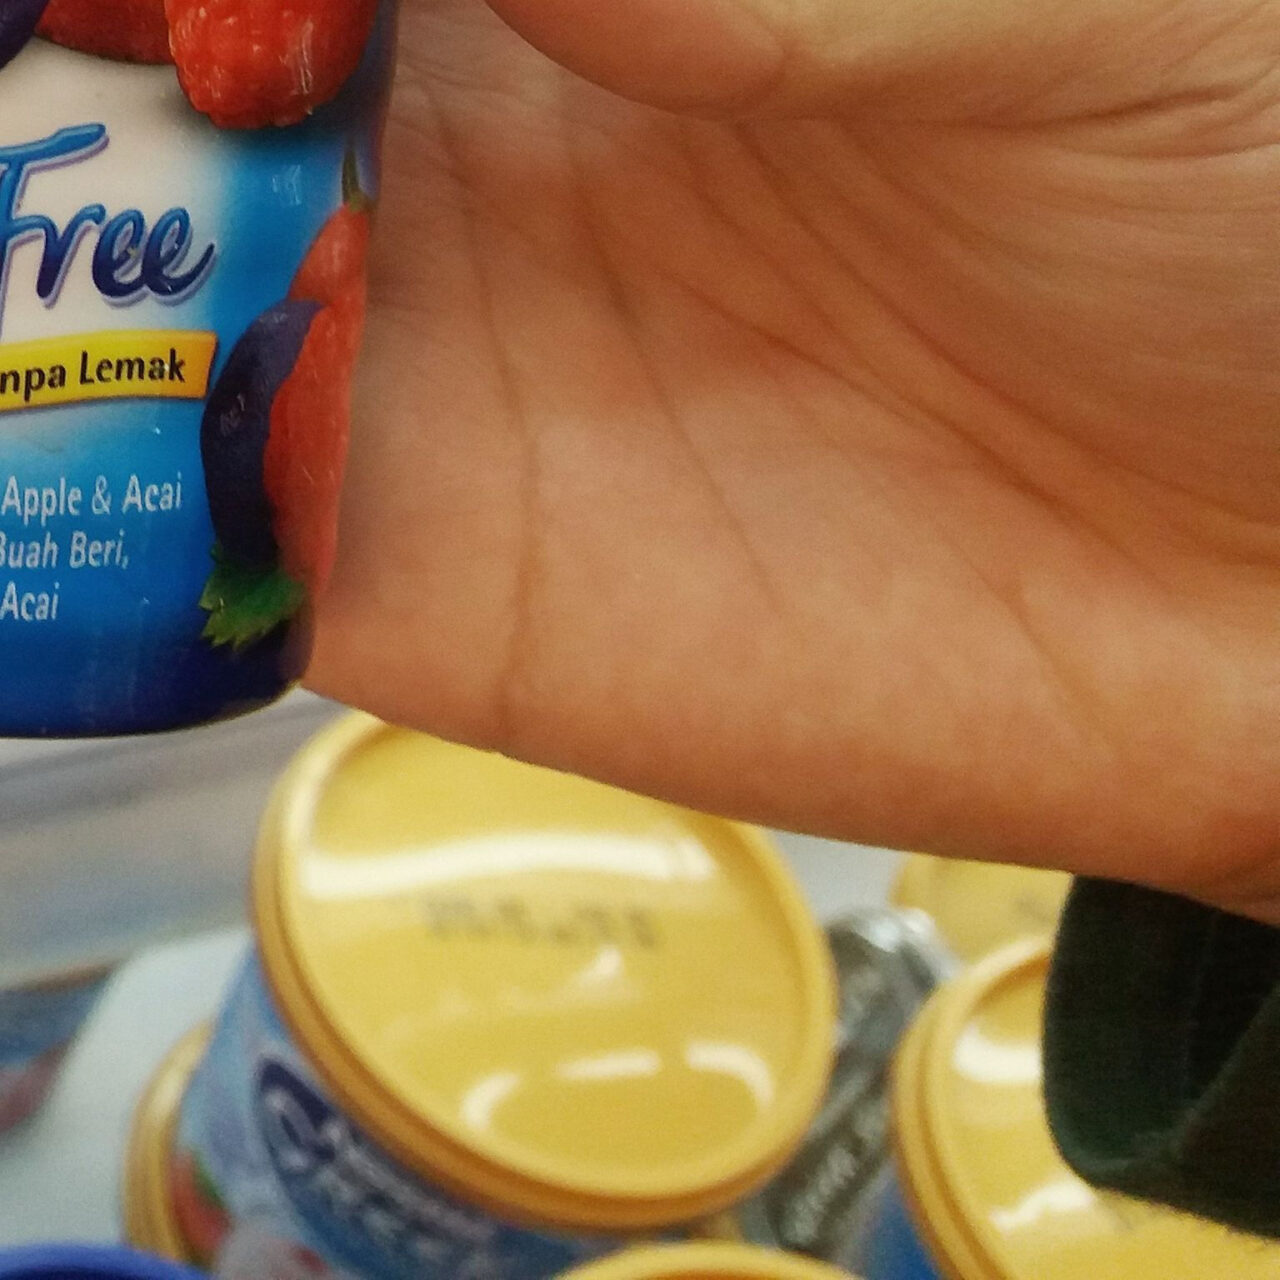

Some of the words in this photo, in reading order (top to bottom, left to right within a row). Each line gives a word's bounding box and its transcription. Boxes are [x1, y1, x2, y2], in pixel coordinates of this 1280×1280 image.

[79, 348, 186, 385] Lemak
[1, 475, 82, 526] Apple
[91, 474, 111, 515] &
[122, 471, 182, 513] Acai
[69, 529, 129, 570] Beri,
